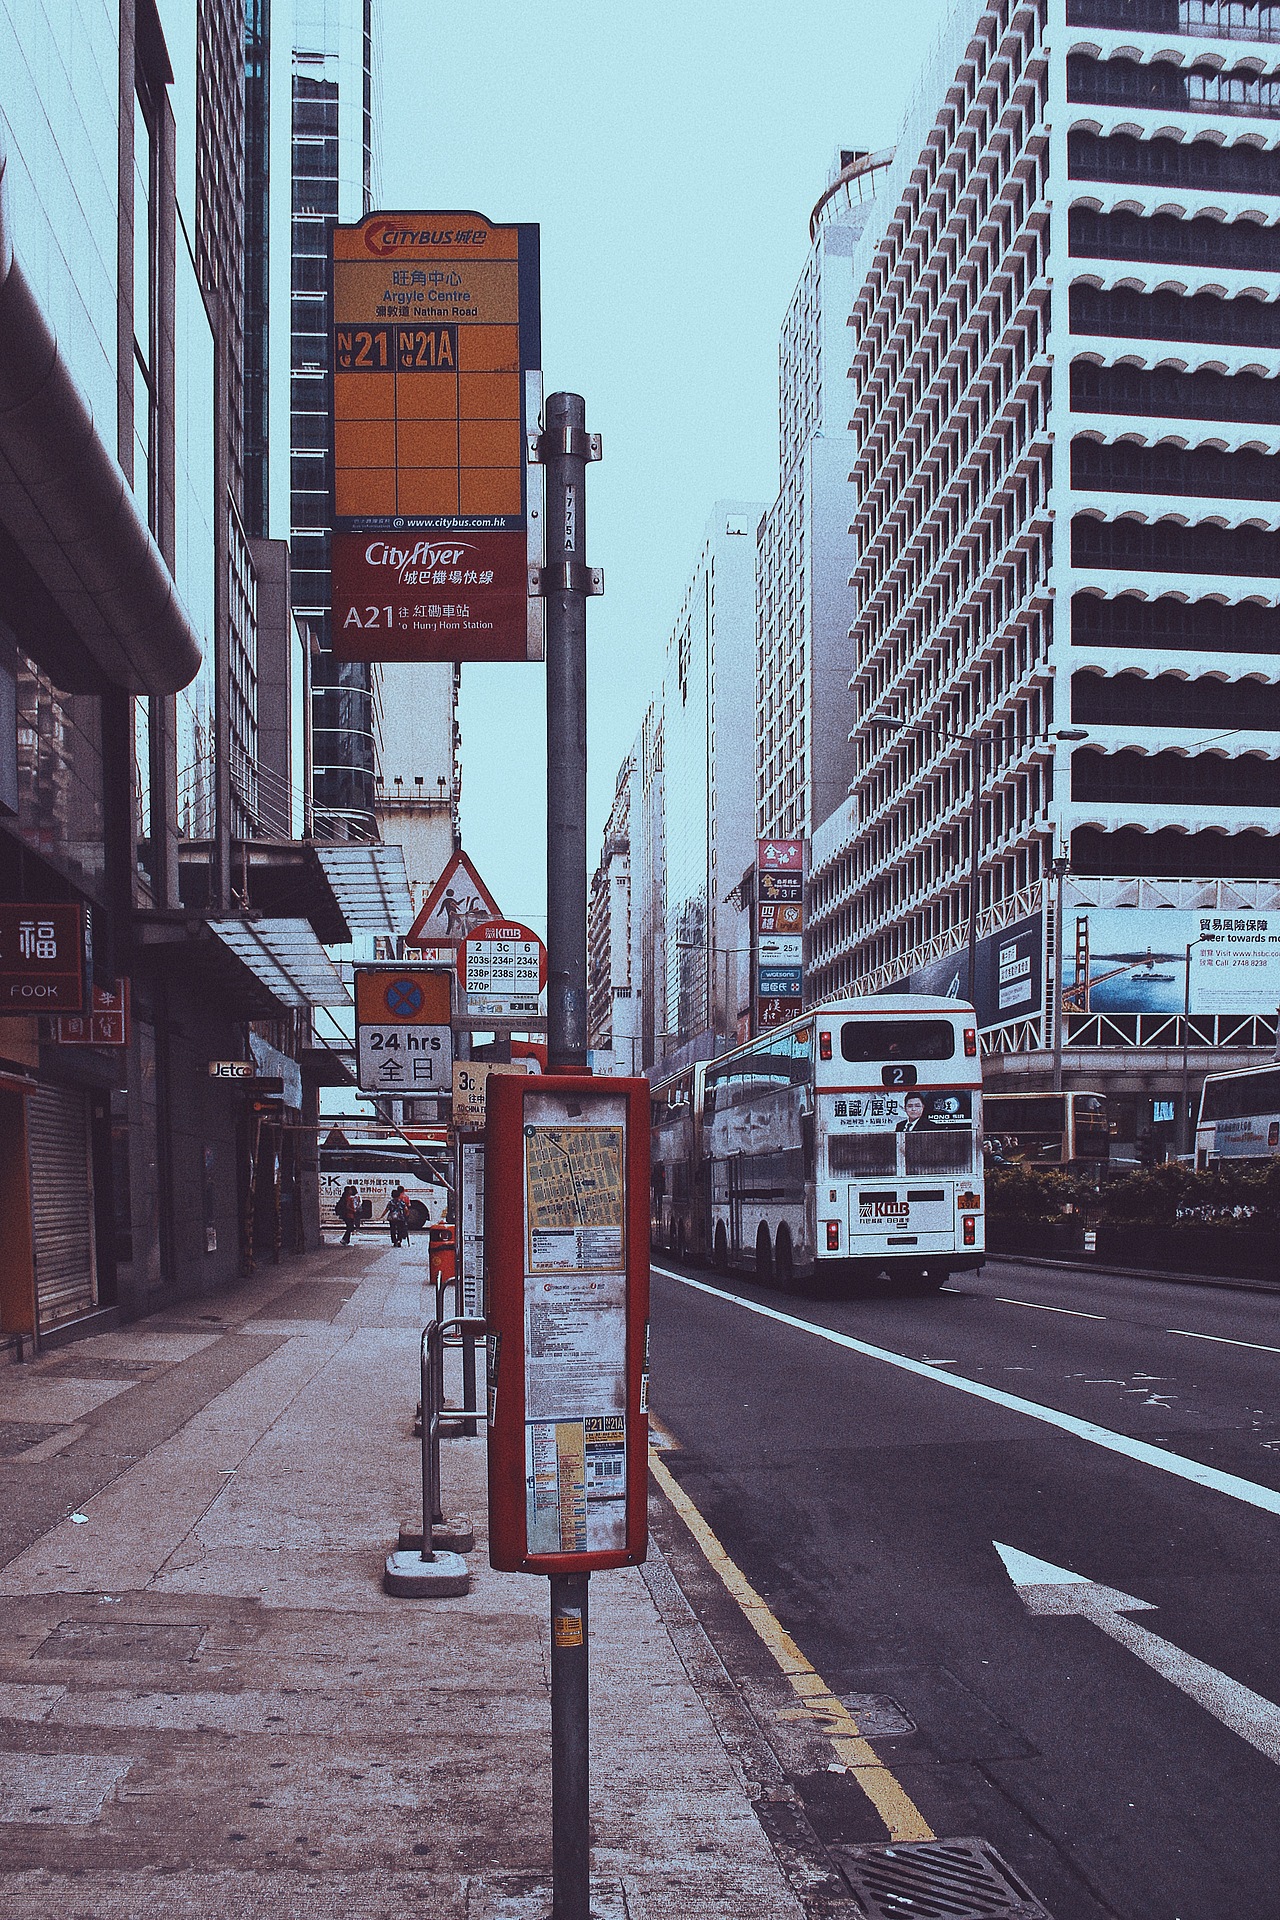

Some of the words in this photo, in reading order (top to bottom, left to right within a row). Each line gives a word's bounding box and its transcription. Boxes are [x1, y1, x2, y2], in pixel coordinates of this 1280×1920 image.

[383, 231, 454, 244] CITYBUS
[455, 230, 487, 244] 城巴
[392, 269, 462, 286] 旺角中心
[383, 290, 424, 304] Argyle
[428, 290, 470, 302] Centre
[375, 305, 409, 317] 彌敦道
[413, 307, 449, 316] Nathan
[452, 307, 478, 316] Road
[407, 517, 506, 528] www.citybus.com.hk
[365, 541, 472, 572] Cityflyer
[404, 570, 494, 585] 城巴機場快線
[343, 605, 393, 629] A21
[398, 607, 410, 618] 往
[413, 604, 470, 618] 紅磡車站
[413, 621, 437, 631] Hung
[440, 621, 460, 630] Hom
[463, 621, 493, 629] Station
[1200, 919, 1268, 931] 貿易風險保障
[19, 921, 57, 959] 福
[495, 928, 522, 939] KMB
[1227, 933, 1266, 942] towards
[475, 942, 482, 952] 2
[496, 943, 510, 952] 3C
[524, 944, 531, 952] 6
[468, 956, 490, 964] 203S
[492, 956, 514, 965] 234P
[516, 957, 538, 965] 234X
[468, 969, 490, 977] 238P
[492, 969, 514, 978] 238S
[11, 985, 58, 997] FOOK
[468, 982, 490, 990] 270P
[785, 1009, 800, 1018] 2/F
[371, 1033, 400, 1050] 24
[407, 1034, 441, 1050] hrs
[211, 1063, 253, 1077] Jetco
[379, 1058, 433, 1081] 全日
[892, 1068, 904, 1084] 2
[874, 1202, 910, 1217] KMB
